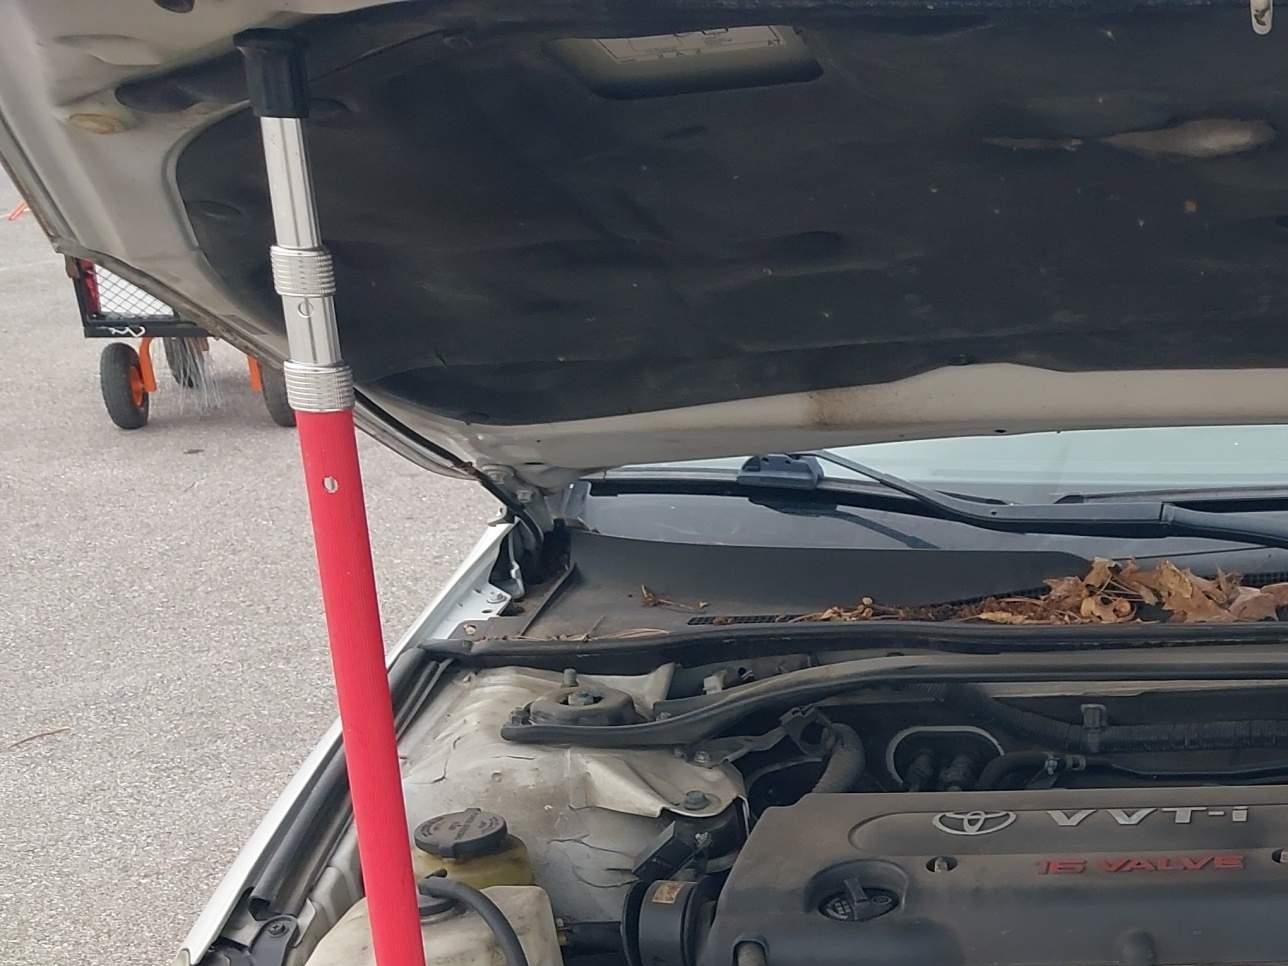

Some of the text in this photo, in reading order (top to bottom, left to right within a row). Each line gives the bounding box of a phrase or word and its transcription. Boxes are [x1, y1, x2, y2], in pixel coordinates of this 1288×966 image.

[1047, 805, 1249, 826] VVT-i
[1037, 855, 1246, 875] 16 VALVE
